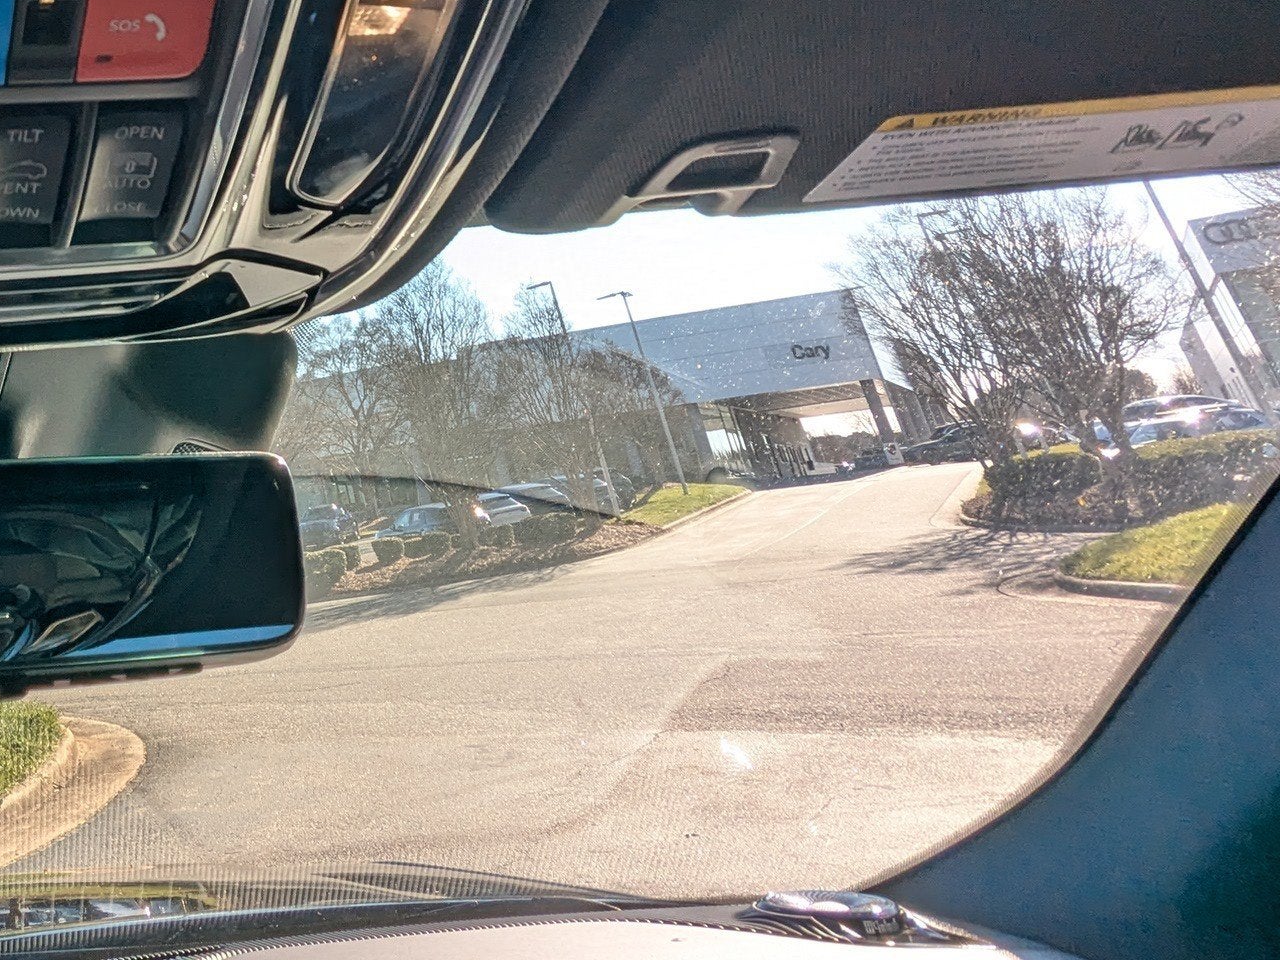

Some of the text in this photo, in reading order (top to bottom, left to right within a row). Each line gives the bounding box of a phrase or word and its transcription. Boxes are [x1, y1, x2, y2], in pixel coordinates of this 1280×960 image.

[109, 19, 140, 32] SOS
[7, 128, 44, 143] TILT
[114, 125, 165, 140] OPEN
[791, 344, 830, 360] Cary
